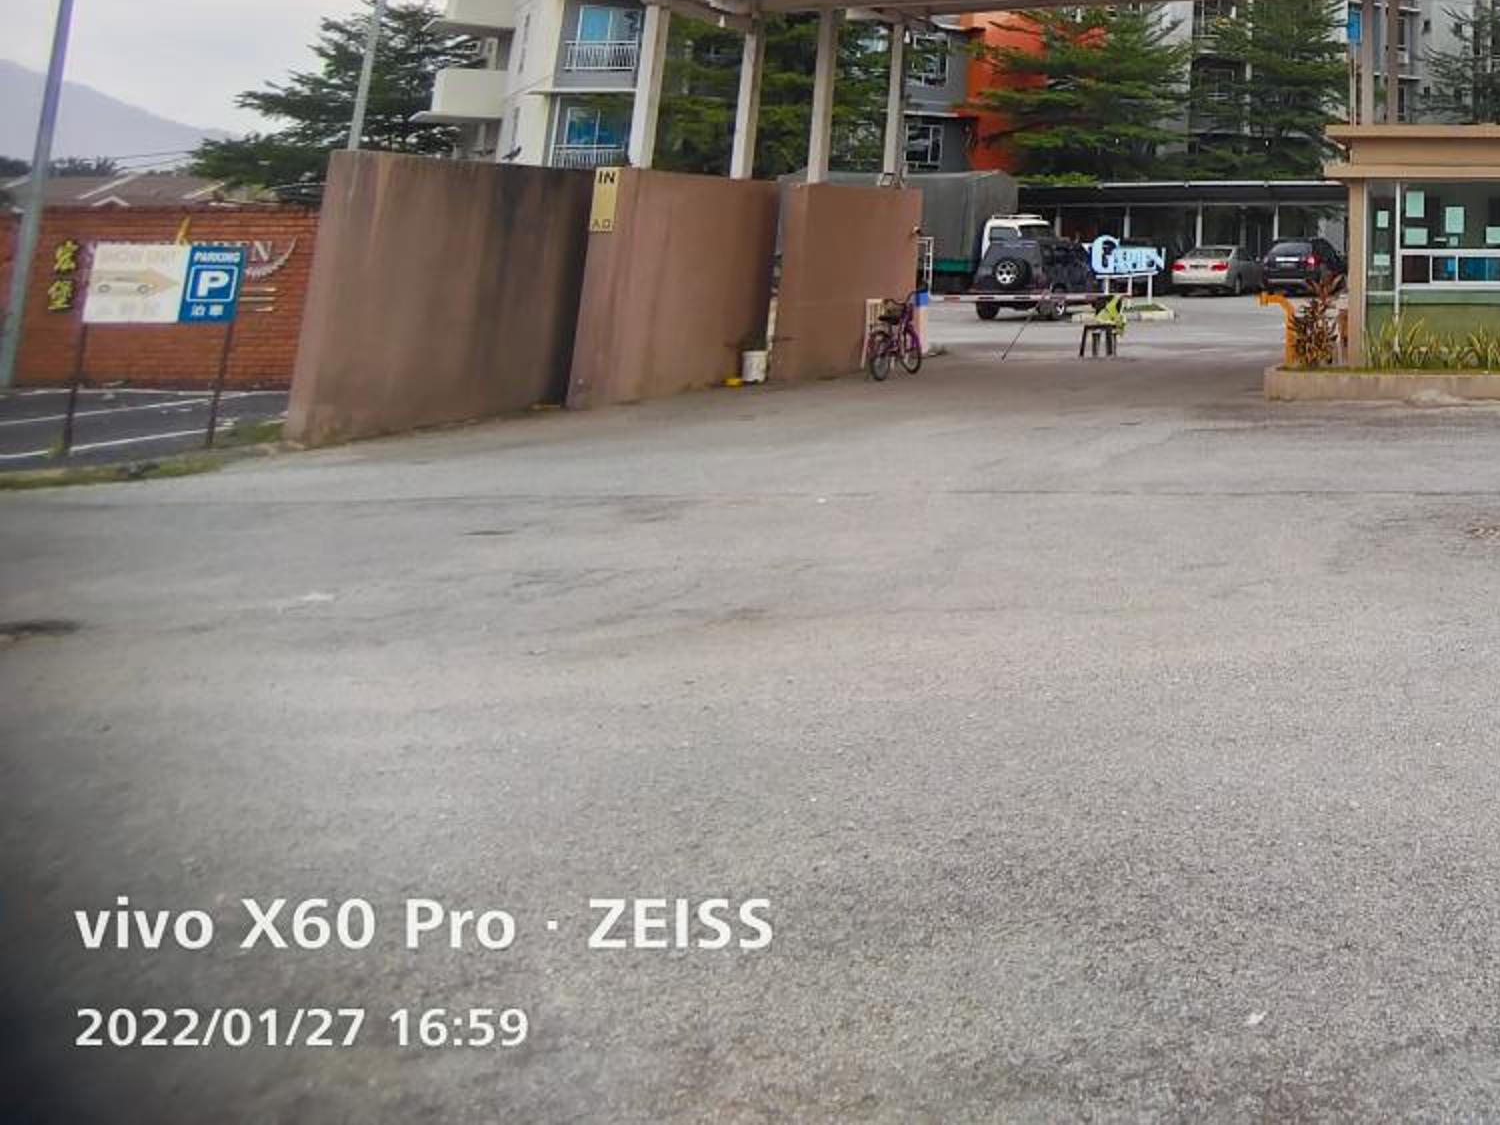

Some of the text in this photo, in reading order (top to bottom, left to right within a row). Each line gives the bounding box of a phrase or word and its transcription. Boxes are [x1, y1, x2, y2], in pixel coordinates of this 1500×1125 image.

[599, 171, 616, 184] IN
[193, 252, 241, 263] PARKING
[197, 271, 230, 297] P
